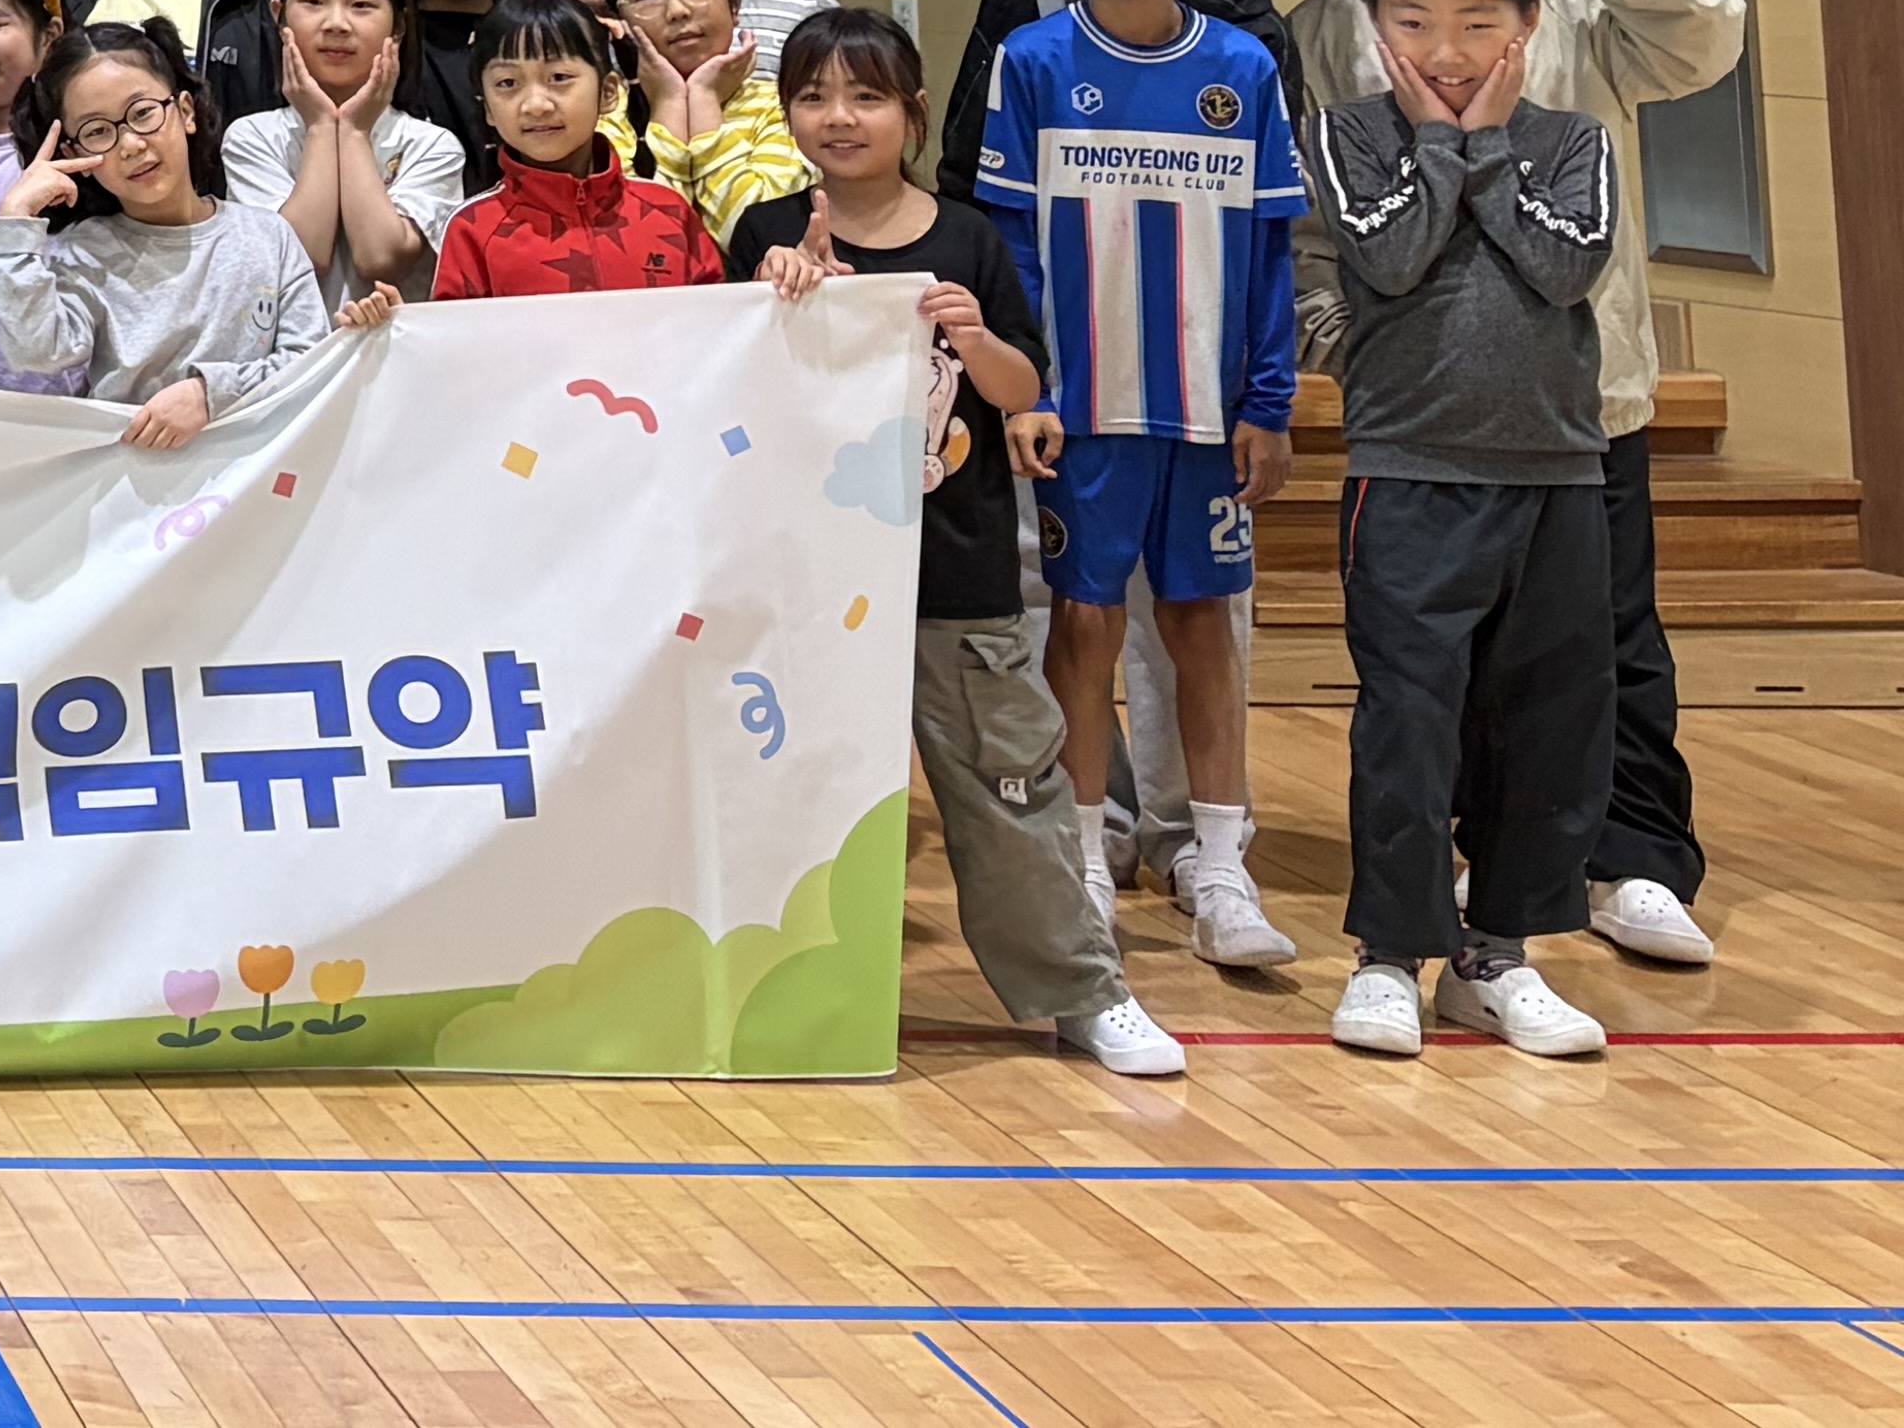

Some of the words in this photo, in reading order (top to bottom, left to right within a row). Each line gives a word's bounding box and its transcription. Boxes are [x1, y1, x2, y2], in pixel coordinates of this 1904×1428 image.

[1060, 145, 1200, 173] TONGYEONG
[1206, 153, 1245, 176] U12
[1081, 172, 1175, 187] FOOTBALL
[1184, 176, 1226, 191] CLUB
[1208, 495, 1253, 552] 25
